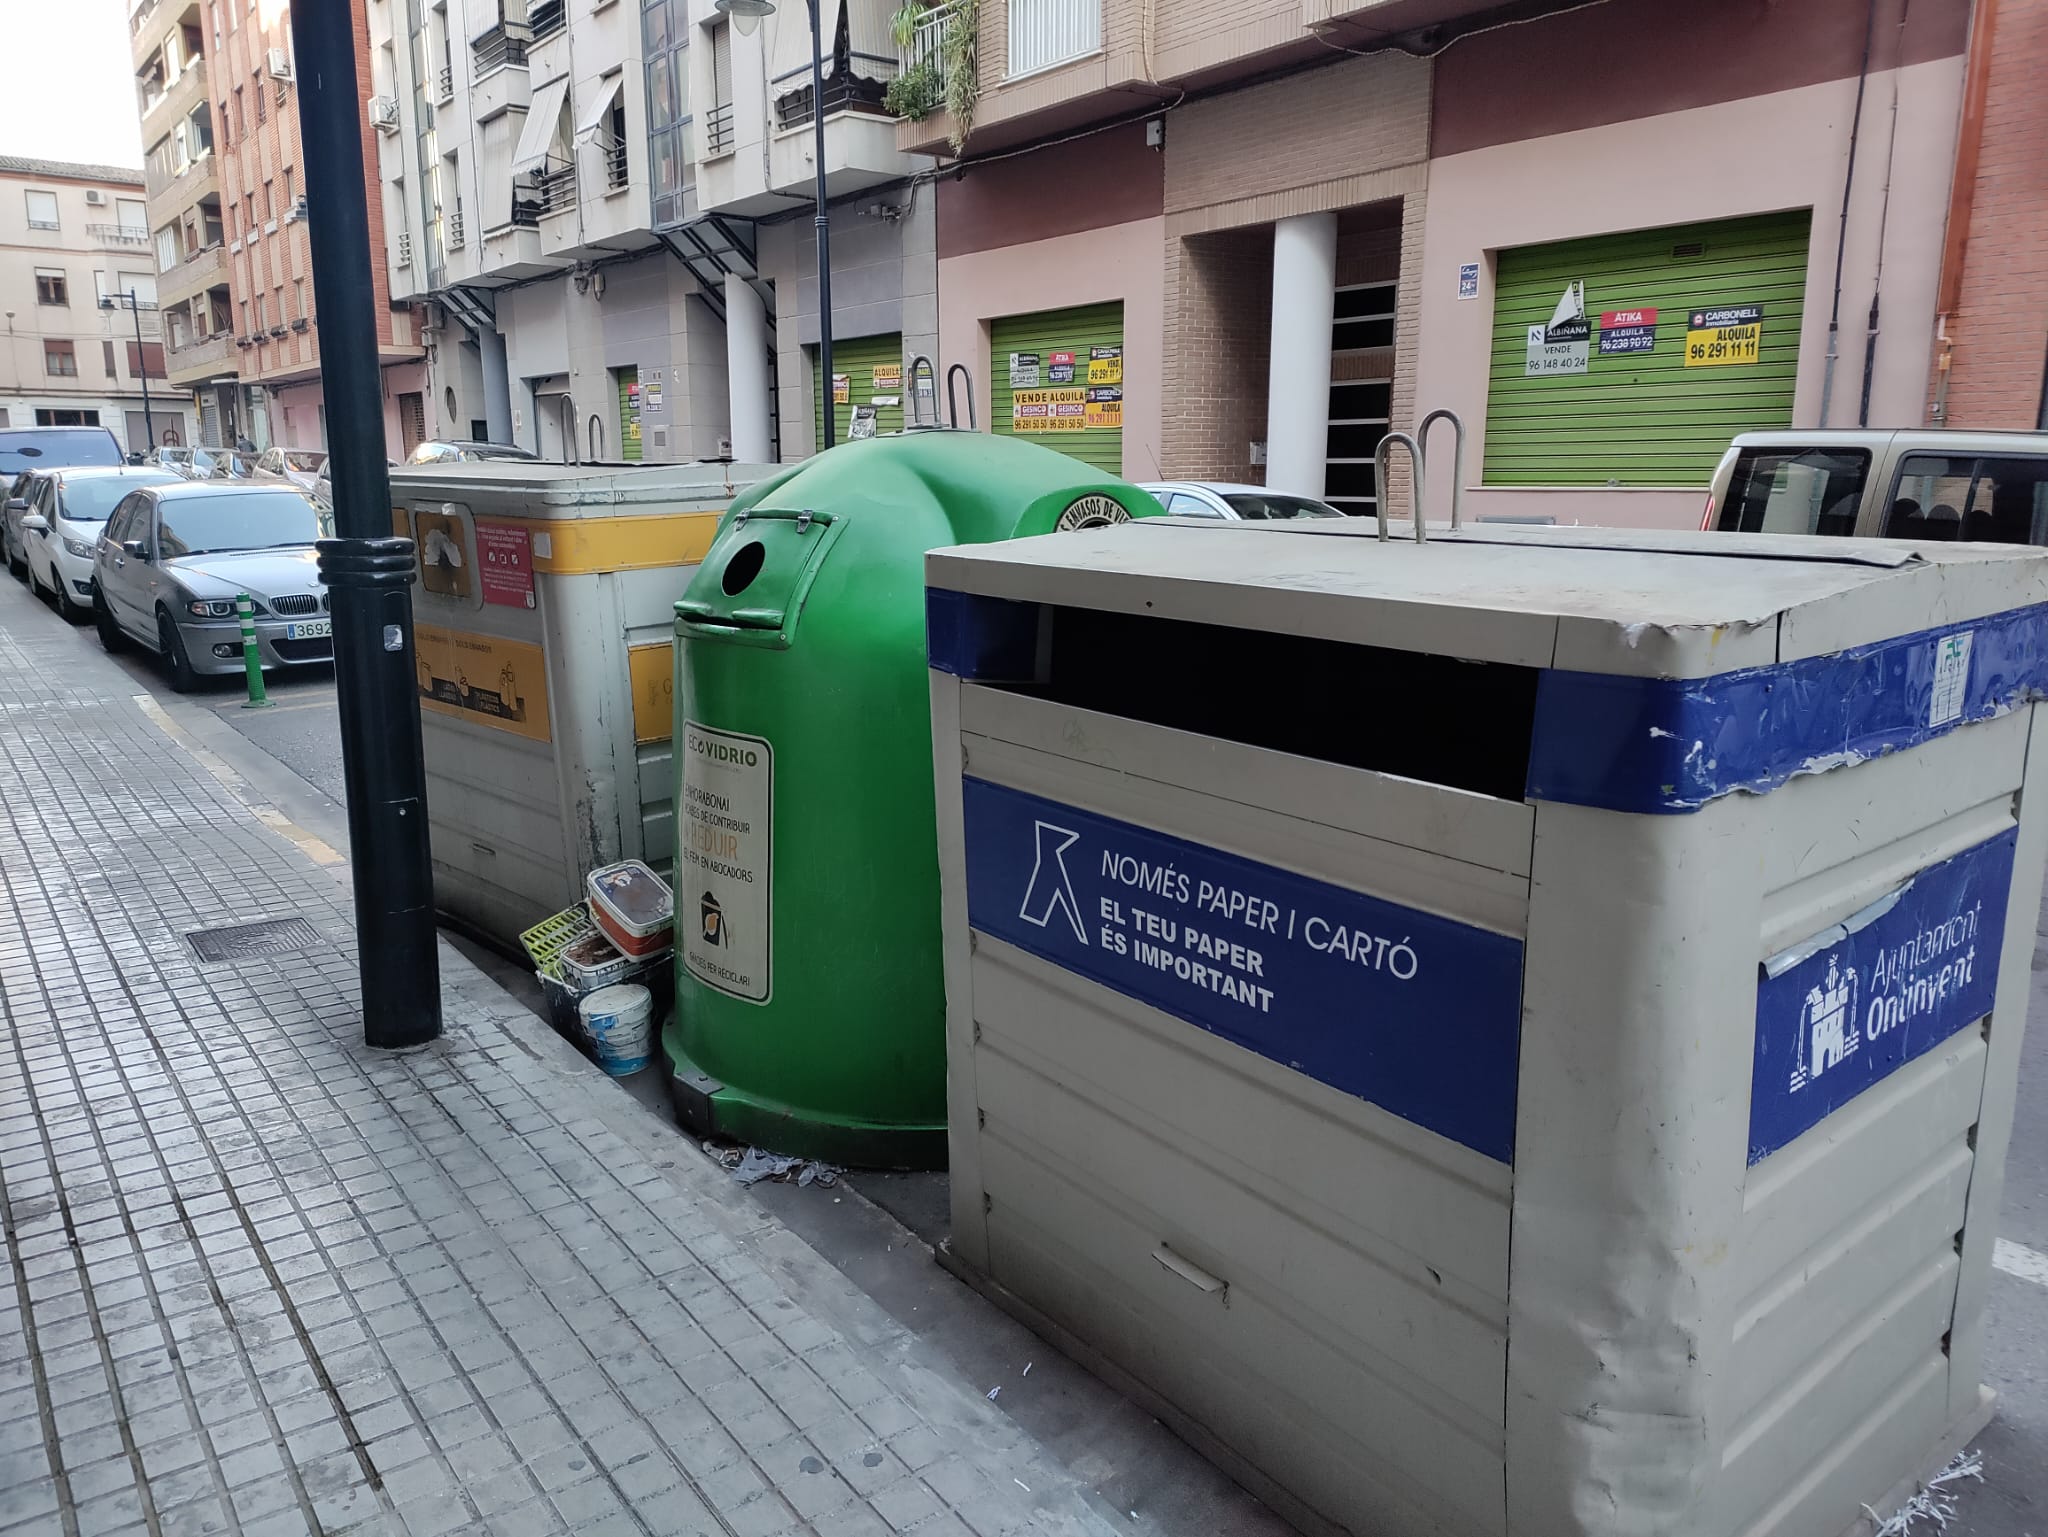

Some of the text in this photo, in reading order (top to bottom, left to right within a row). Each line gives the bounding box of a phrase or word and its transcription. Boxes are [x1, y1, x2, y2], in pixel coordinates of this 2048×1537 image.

[1614, 311, 1643, 322] ATIKA
[1705, 308, 1759, 321] CARBONELL
[1547, 325, 1588, 337] ALBIÑANA
[1611, 327, 1644, 337] ALQUILA
[1717, 327, 1756, 341] ALQUILA
[1544, 344, 1572, 354] VENDE
[1601, 340, 1612, 350] 96
[1612, 338, 1629, 349] 238
[1641, 336, 1653, 347] 92
[1690, 341, 1755, 359] 96 291 11 11
[1529, 357, 1586, 370] 96 148 40 24
[874, 367, 900, 377] ALQUILA
[1090, 369, 1098, 380] 96
[1015, 392, 1084, 403] VENDE ALQUILA
[1022, 404, 1083, 413] GESINCO GESINCO
[1102, 403, 1121, 413] ALQUILA
[1014, 418, 1084, 430] 96 291 50 50 96 291 50 50
[1065, 498, 1101, 528] ENVASOS
[1103, 500, 1114, 519] DE
[297, 622, 332, 637] 3692
[689, 734, 758, 767] ECOVIDRIO
[700, 810, 709, 823] DE
[710, 813, 750, 835] CONTRIBUIR
[692, 820, 738, 861] REDUIR
[701, 856, 709, 870] EN
[710, 861, 753, 883] ABOCADORS
[1101, 849, 1418, 980] NOMÉS PAPER I CARTÓ
[1100, 897, 1264, 977] EL TEU PAPER
[1100, 926, 1275, 1014] ÉS IMPORTANT
[1867, 944, 1975, 1041] Ontinyent
